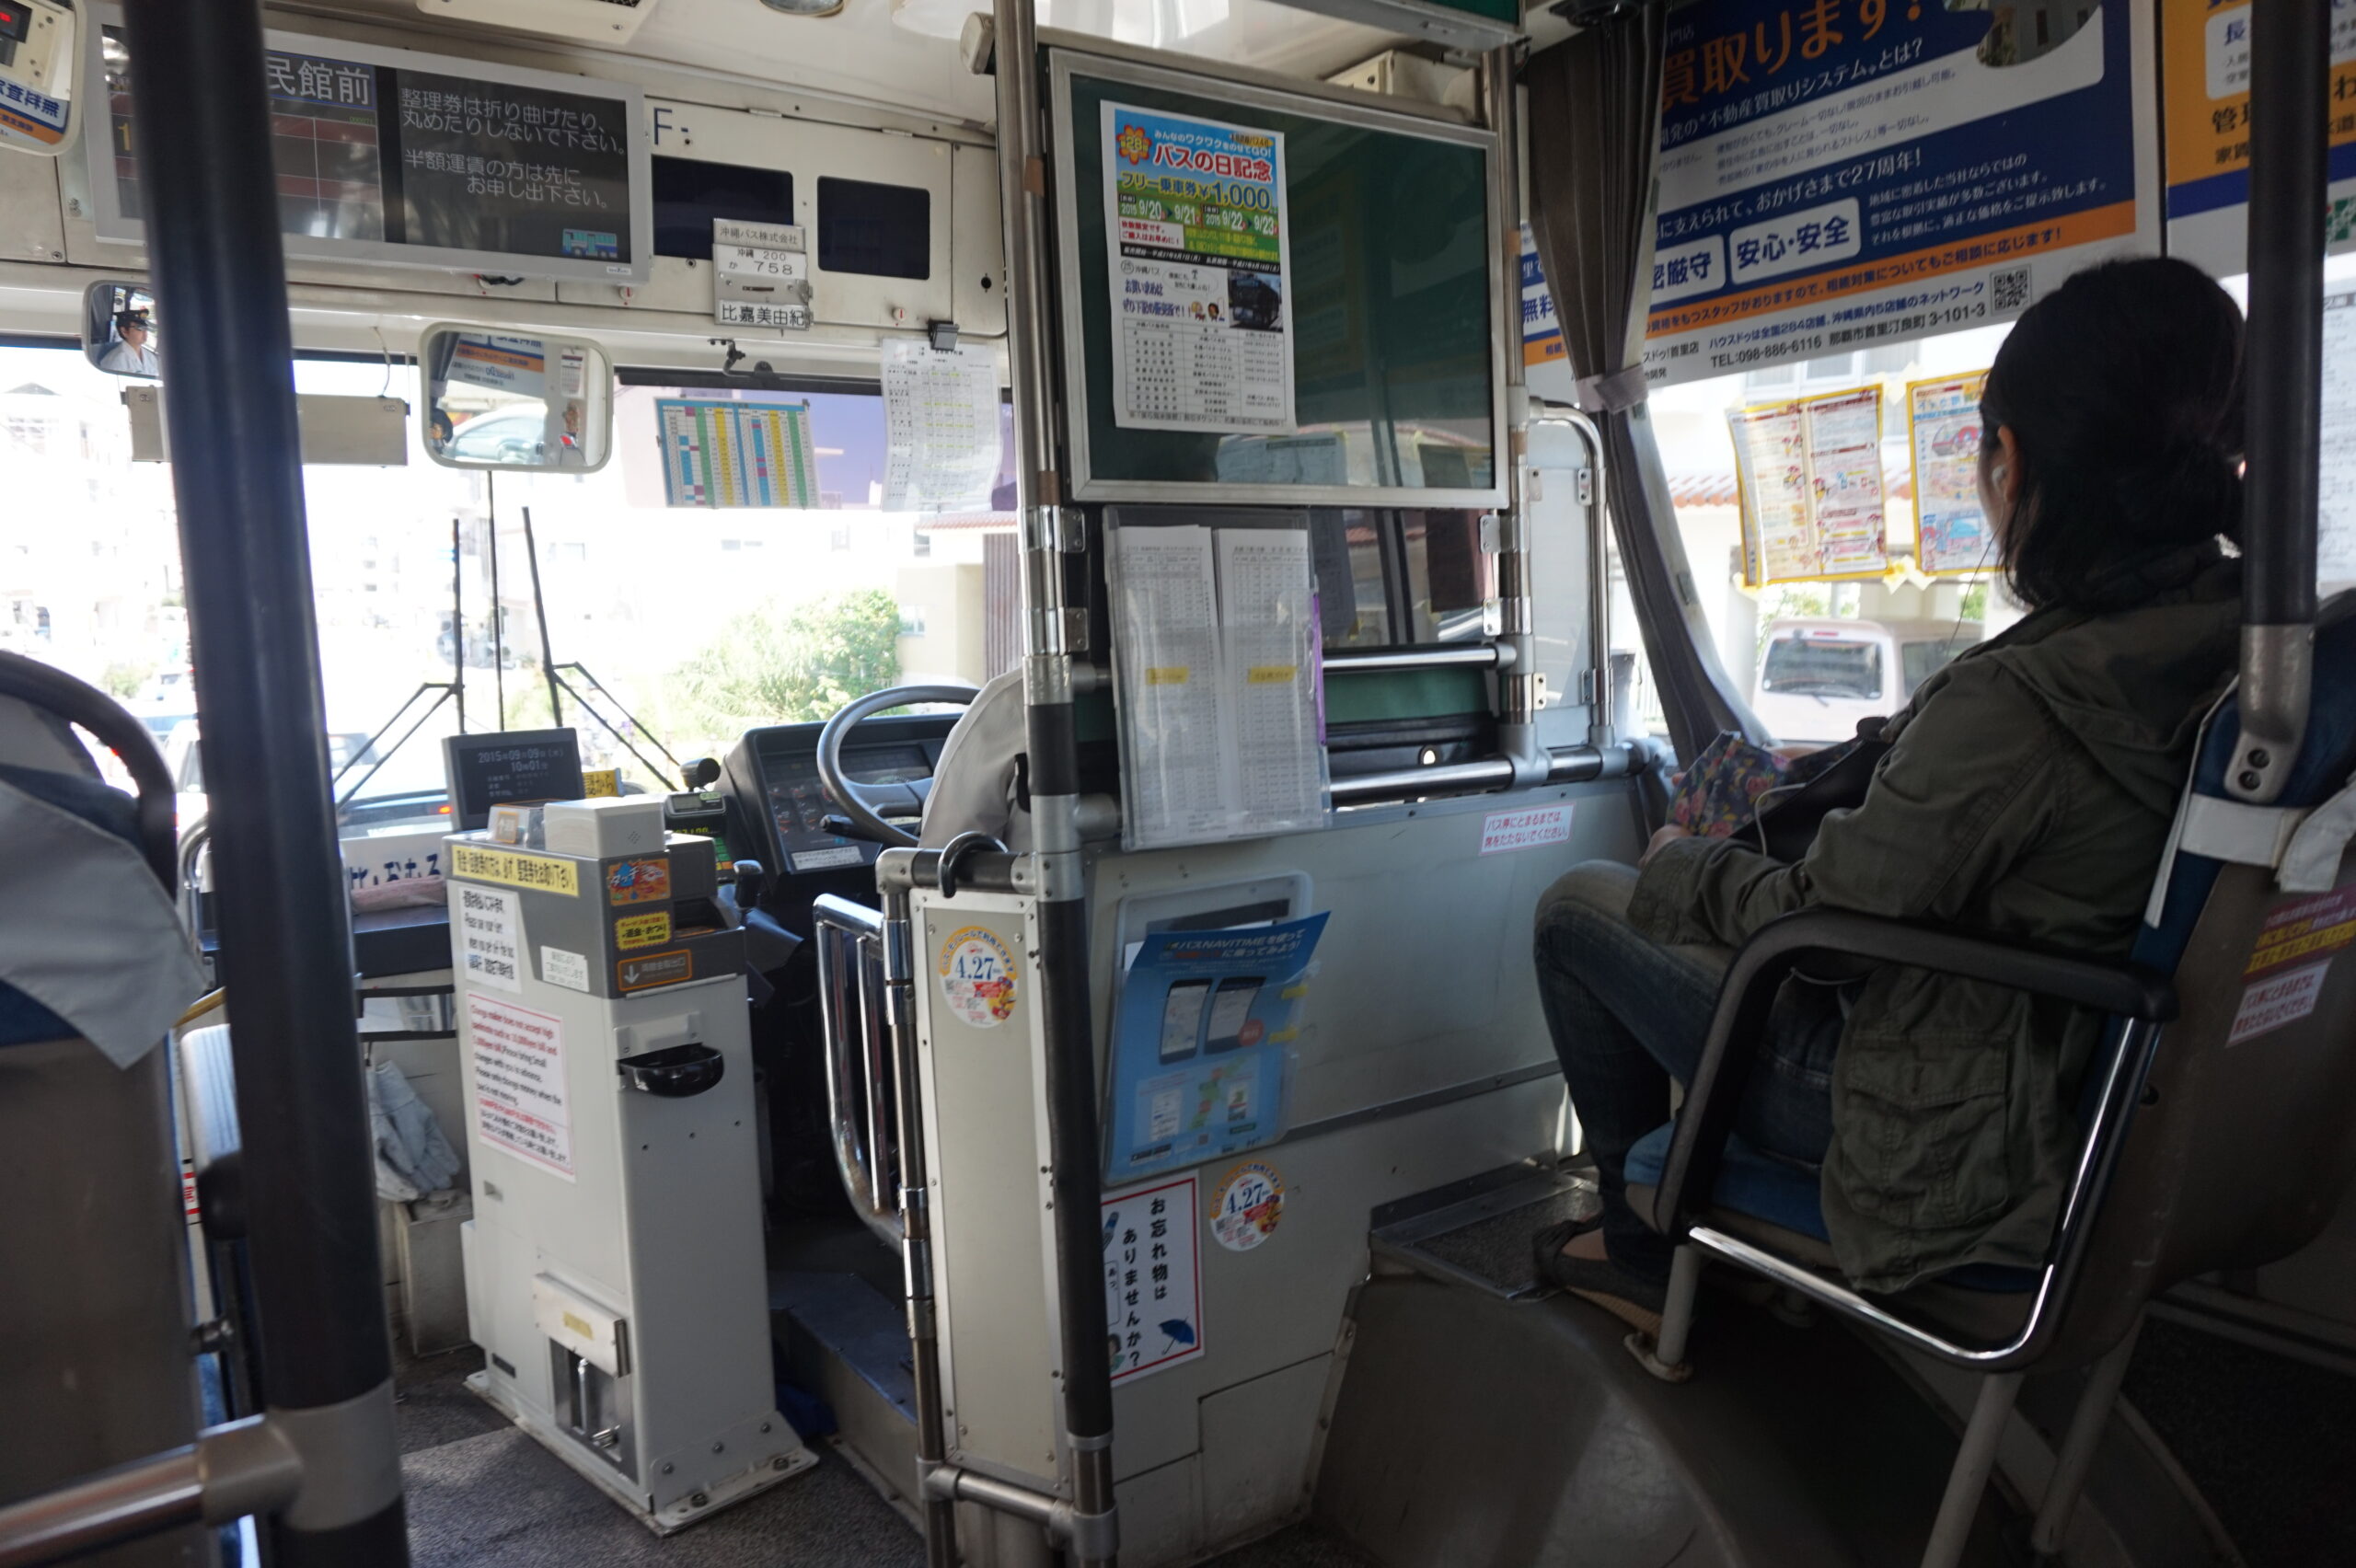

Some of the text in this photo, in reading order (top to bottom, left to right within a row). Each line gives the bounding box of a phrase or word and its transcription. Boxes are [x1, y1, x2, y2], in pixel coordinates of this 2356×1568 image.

[401, 86, 606, 133] 整理券は折り曲げたり、
[403, 109, 625, 156] 丸めたりしないで下さい。
[404, 148, 582, 186] 半額運賃の方は先に
[1153, 144, 1272, 182] バスの日記念
[467, 175, 607, 209] お申し出下さい。
[720, 226, 798, 246] 沖縄バス株式会社
[1738, 214, 1851, 271] 安心・安全
[754, 260, 793, 276] 758
[763, 250, 787, 261] 200
[722, 304, 804, 327] 比嘉美由紀
[1929, 303, 1986, 327] 3-101-3
[956, 955, 995, 981] 4.27
[1226, 1182, 1264, 1215] 4.27
[1150, 1197, 1169, 1302] お忘れ物は
[1122, 1228, 1142, 1367] ありませんか?
